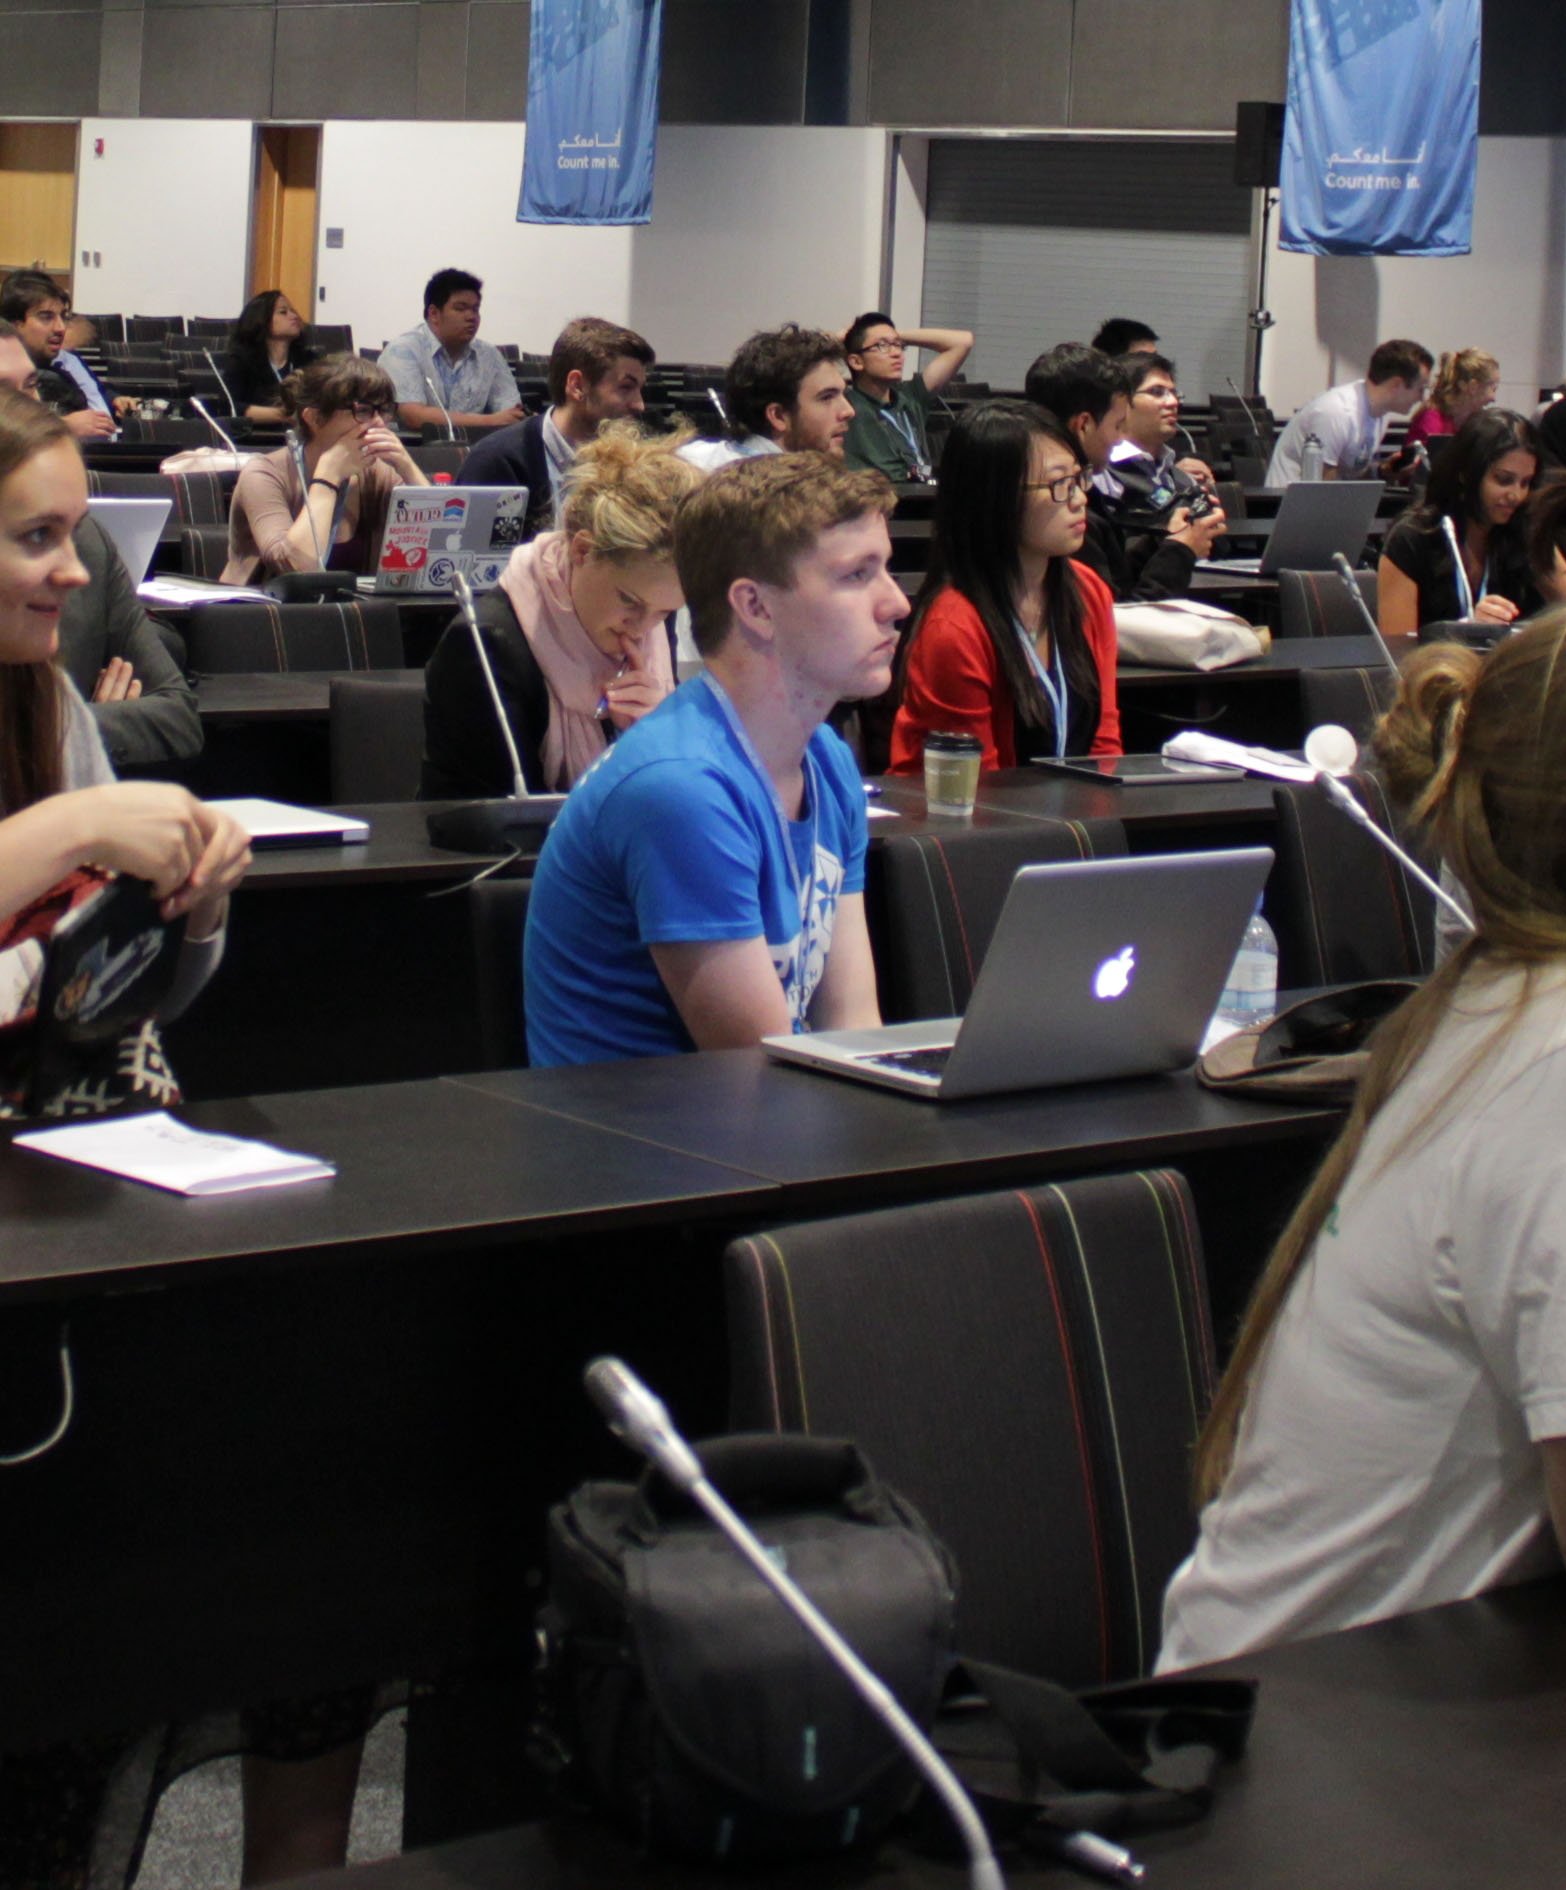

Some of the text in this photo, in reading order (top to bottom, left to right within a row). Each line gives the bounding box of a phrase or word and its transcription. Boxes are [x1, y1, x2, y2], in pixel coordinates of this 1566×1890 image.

[557, 154, 621, 169] Count me in.
[1325, 172, 1373, 190] Count
[1374, 175, 1402, 190] me
